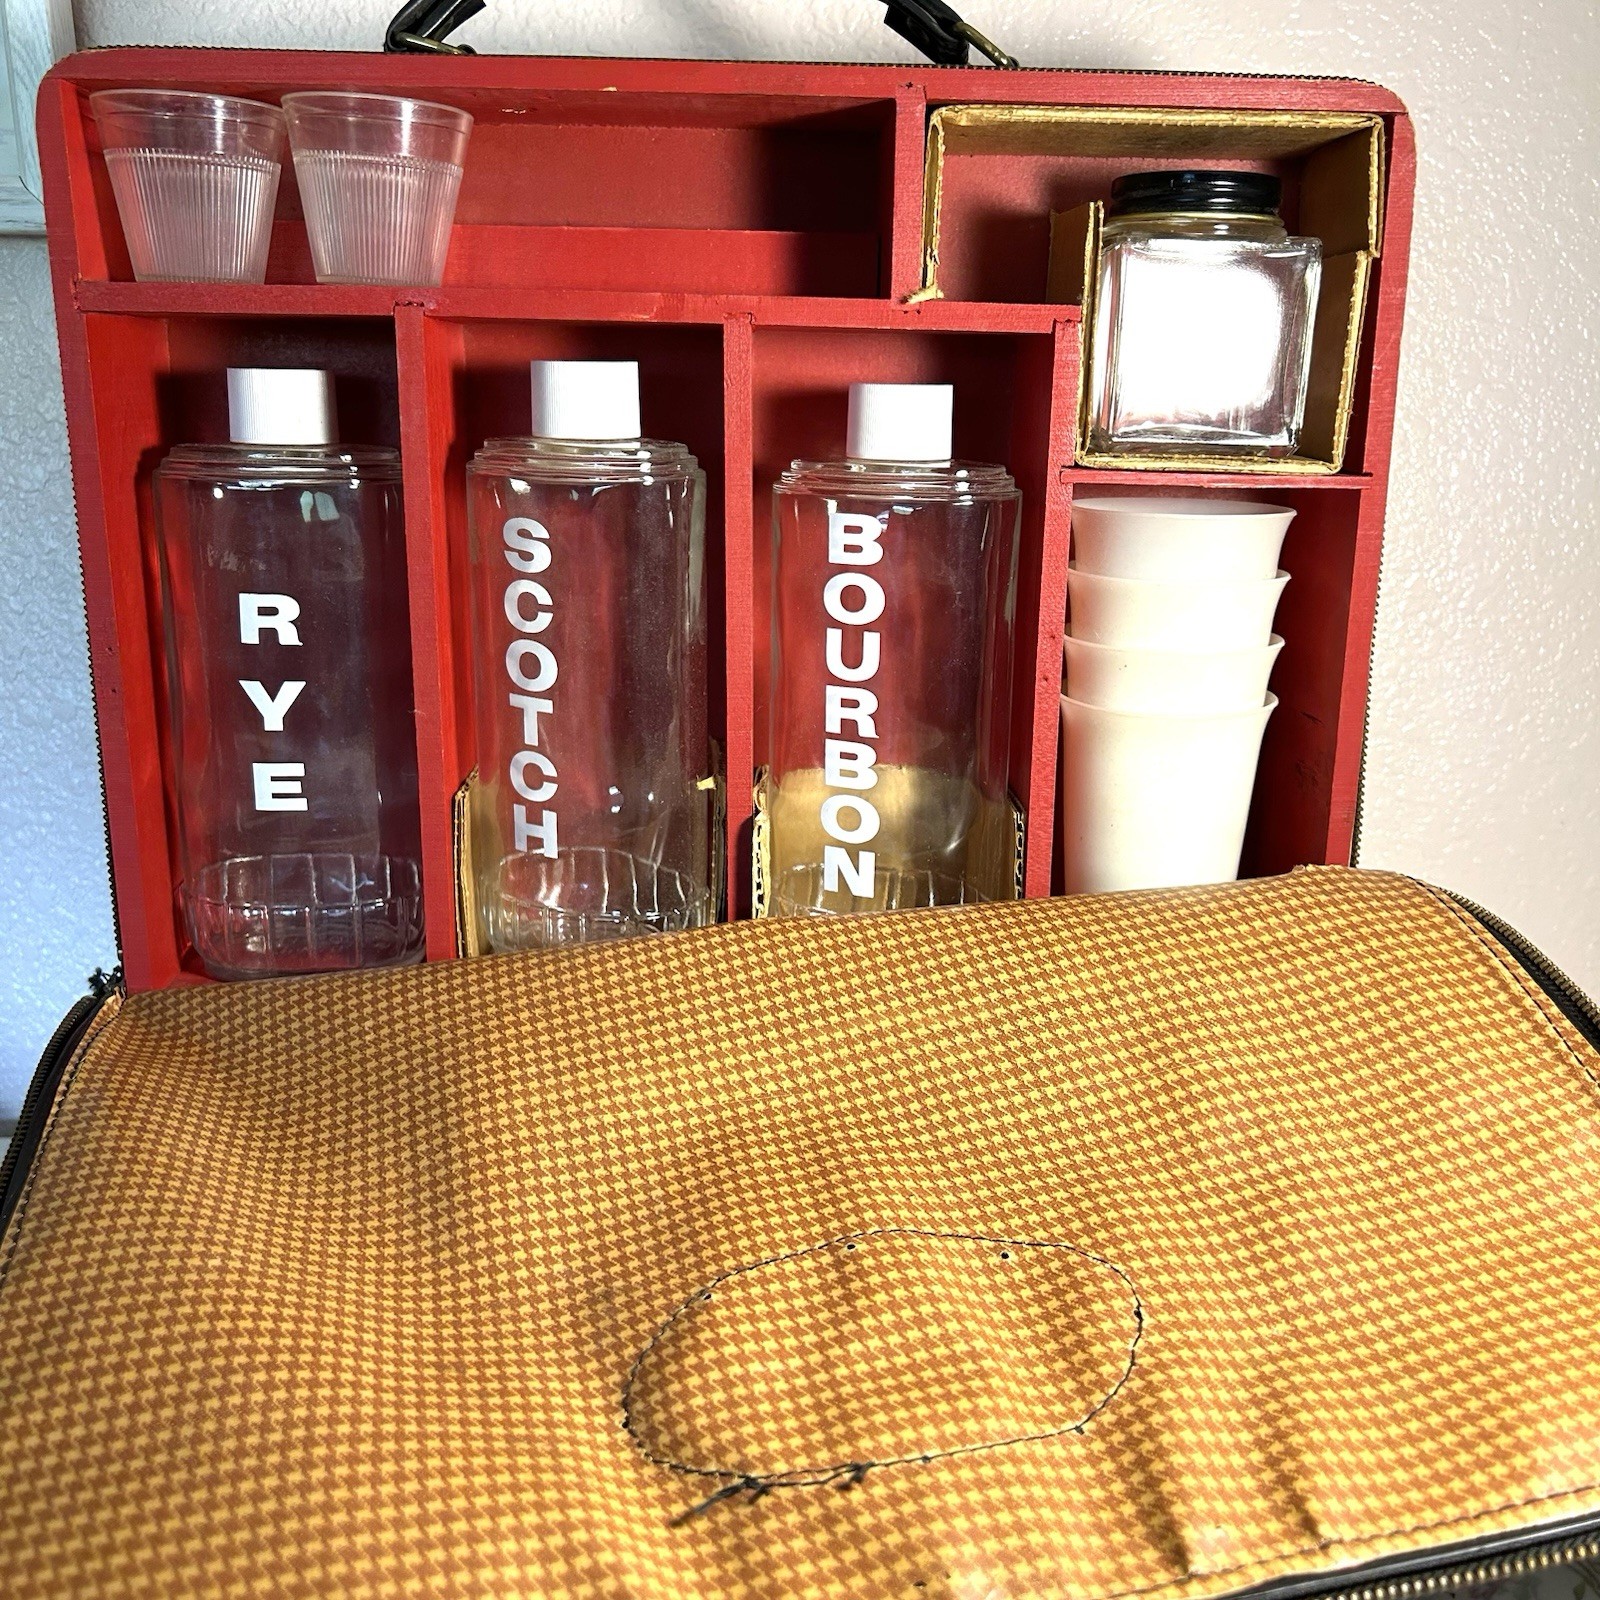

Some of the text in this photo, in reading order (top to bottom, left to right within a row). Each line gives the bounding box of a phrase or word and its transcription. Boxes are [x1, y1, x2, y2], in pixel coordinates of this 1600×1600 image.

[239, 594, 308, 811] RYE
[503, 518, 559, 859] SCOTCH
[821, 512, 886, 898] BOURBON
